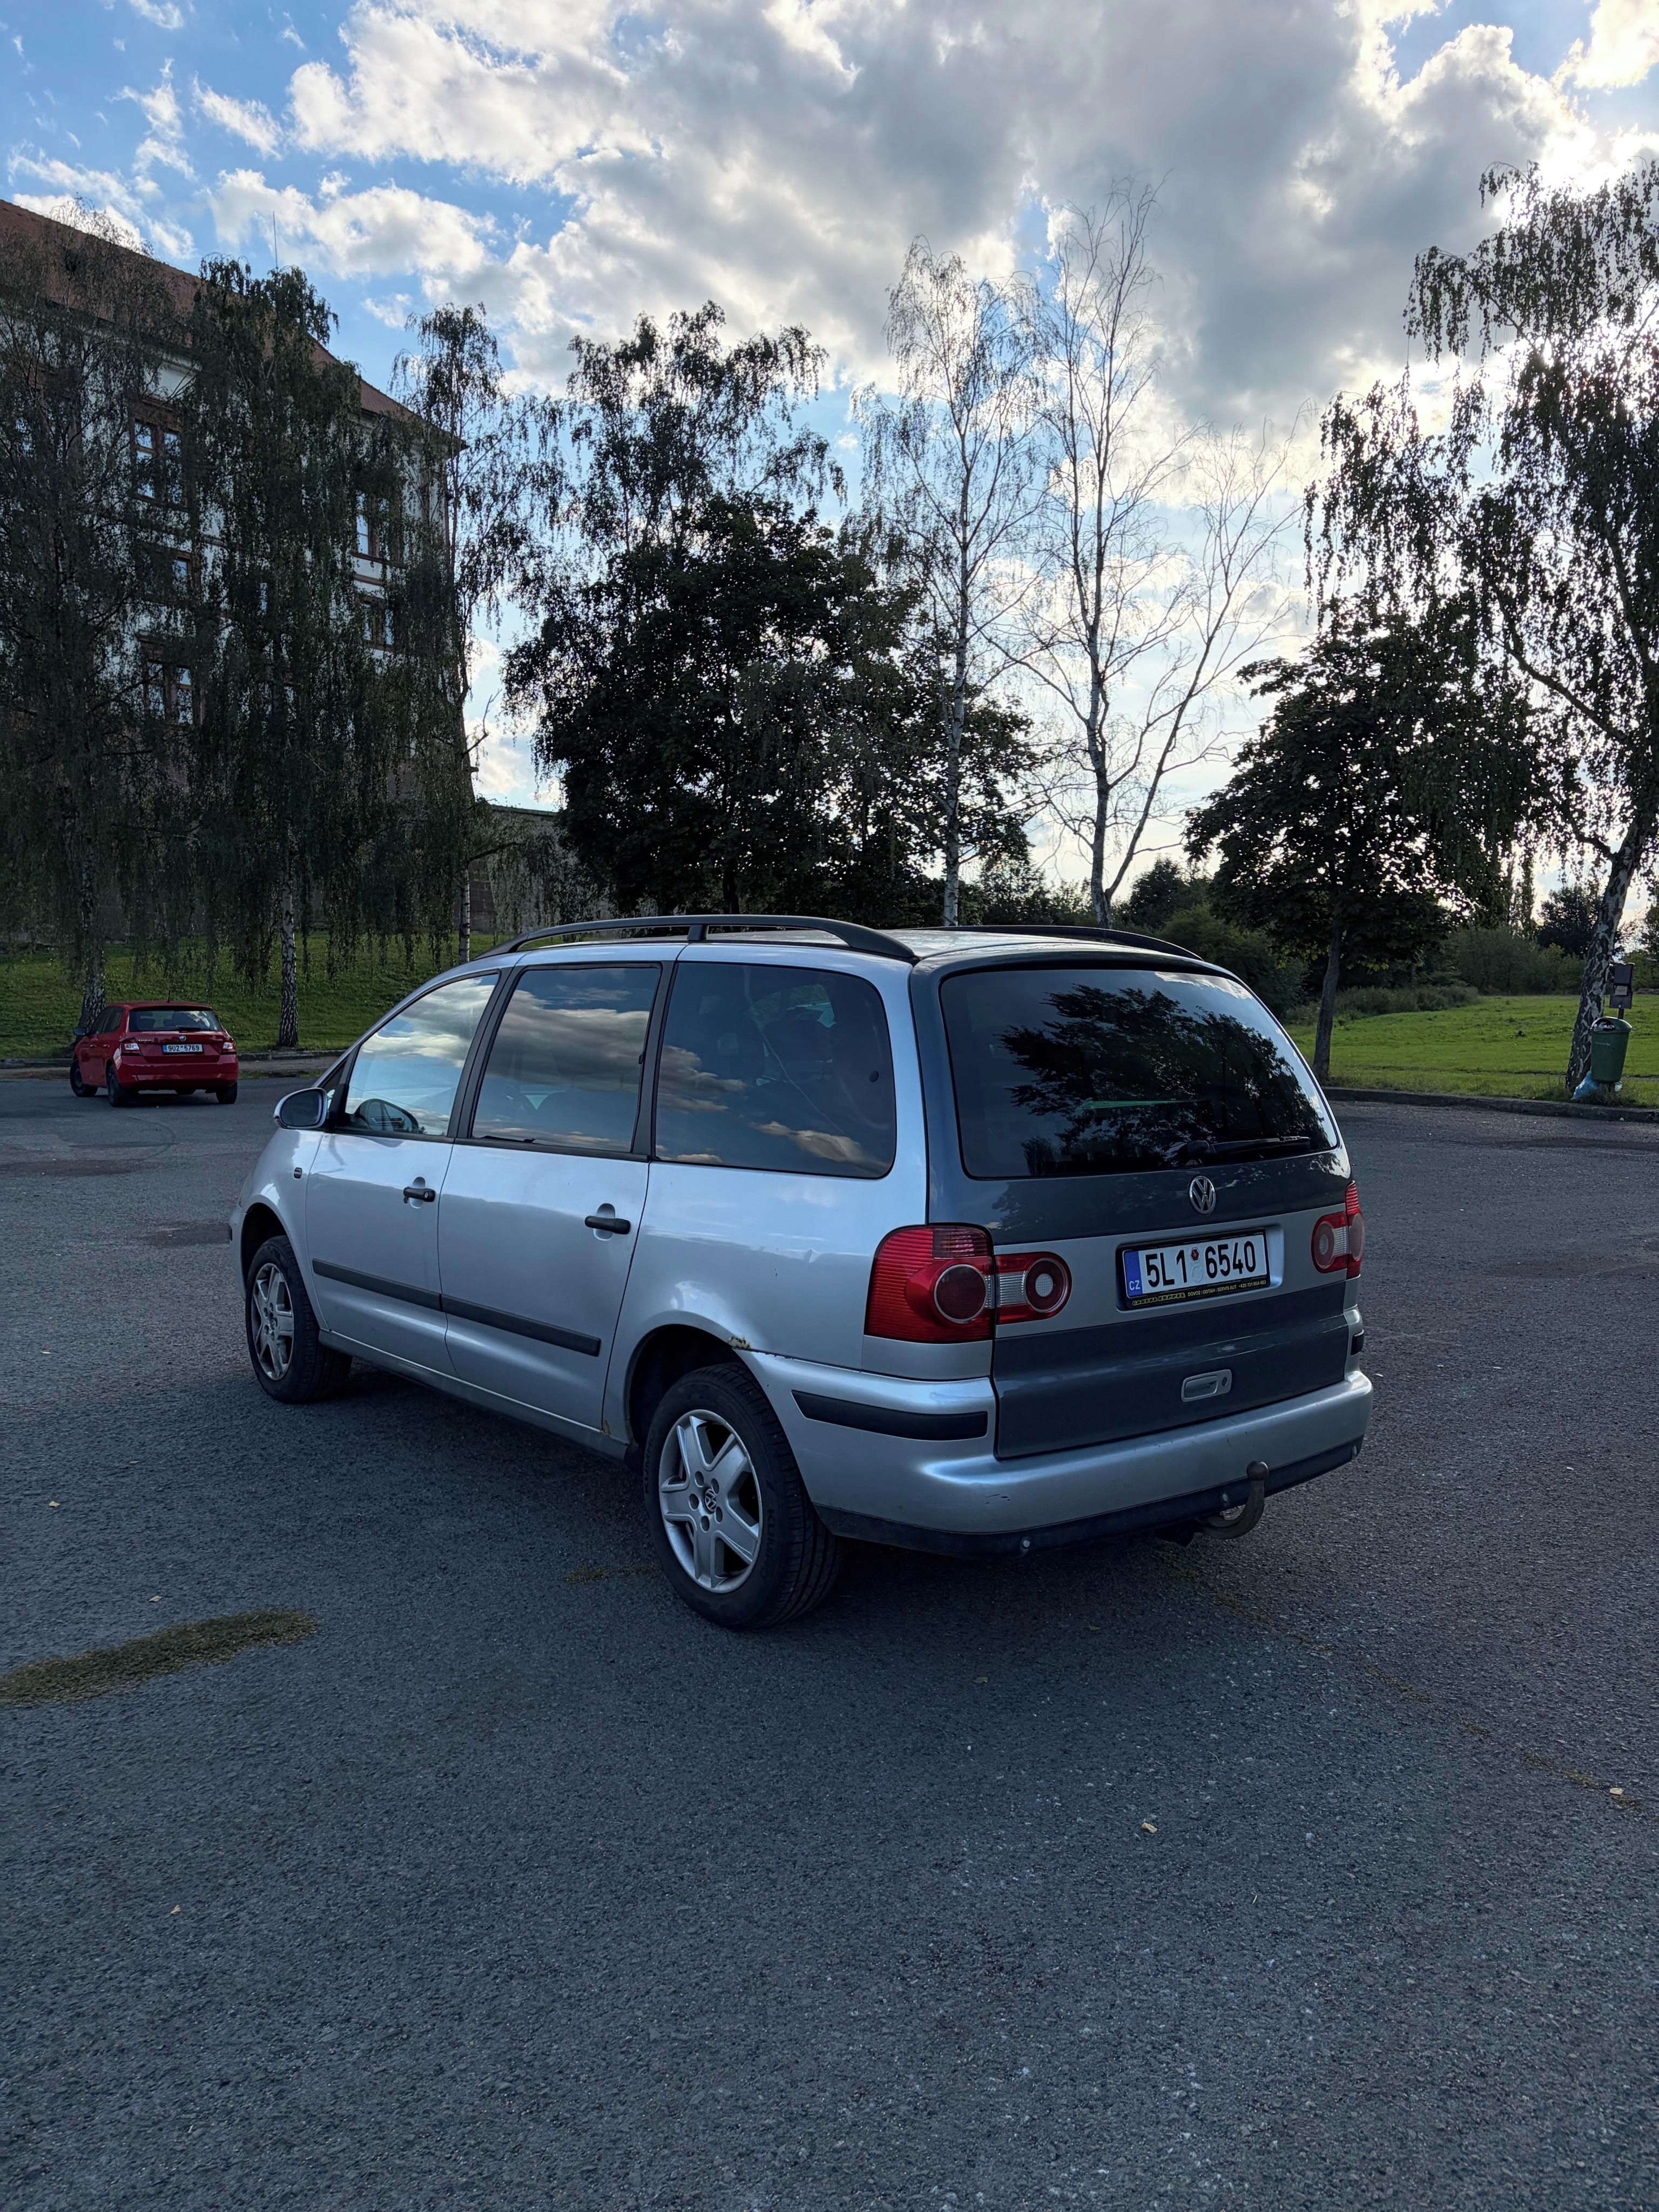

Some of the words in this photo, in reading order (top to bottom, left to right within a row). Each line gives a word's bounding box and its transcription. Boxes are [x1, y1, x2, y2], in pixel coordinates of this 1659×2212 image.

[1145, 1249, 1188, 1287] 5L1
[1205, 1240, 1256, 1279] 6540
[1129, 1279, 1141, 1291] CZ
